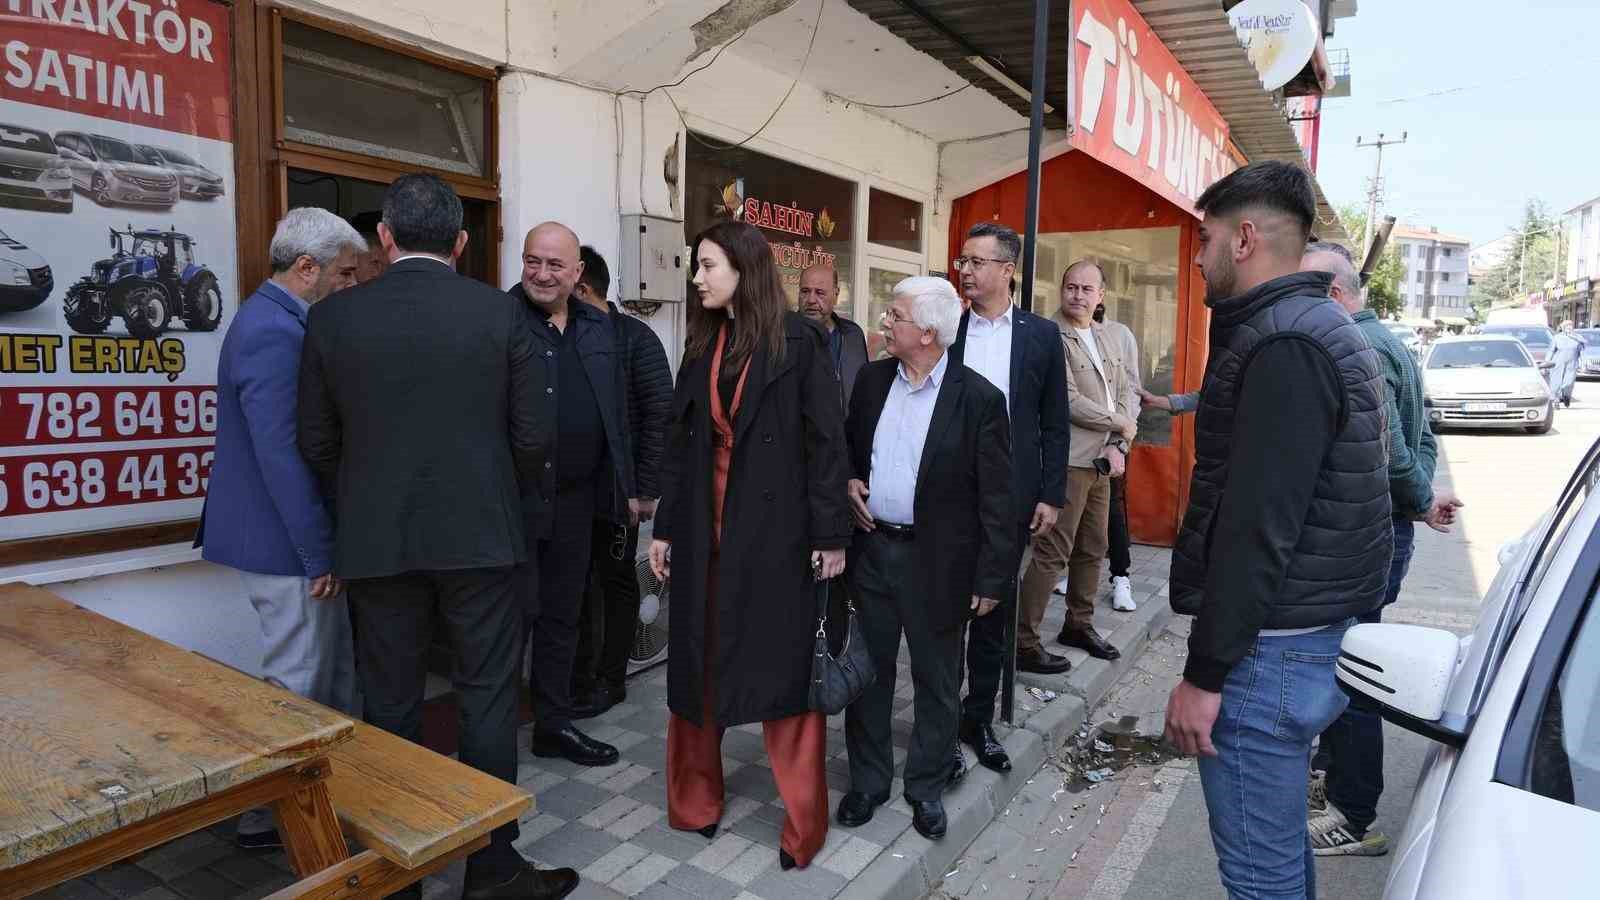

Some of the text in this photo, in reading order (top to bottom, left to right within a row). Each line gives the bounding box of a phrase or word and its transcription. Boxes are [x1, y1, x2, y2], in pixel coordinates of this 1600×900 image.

[8, 0, 214, 63] AKTÖR
[4, 40, 165, 116] SATIMI
[70, 336, 186, 382] ERTAŞ
[18, 390, 218, 440] 782 64 96
[23, 459, 106, 509] 638
[117, 454, 167, 499] 44
